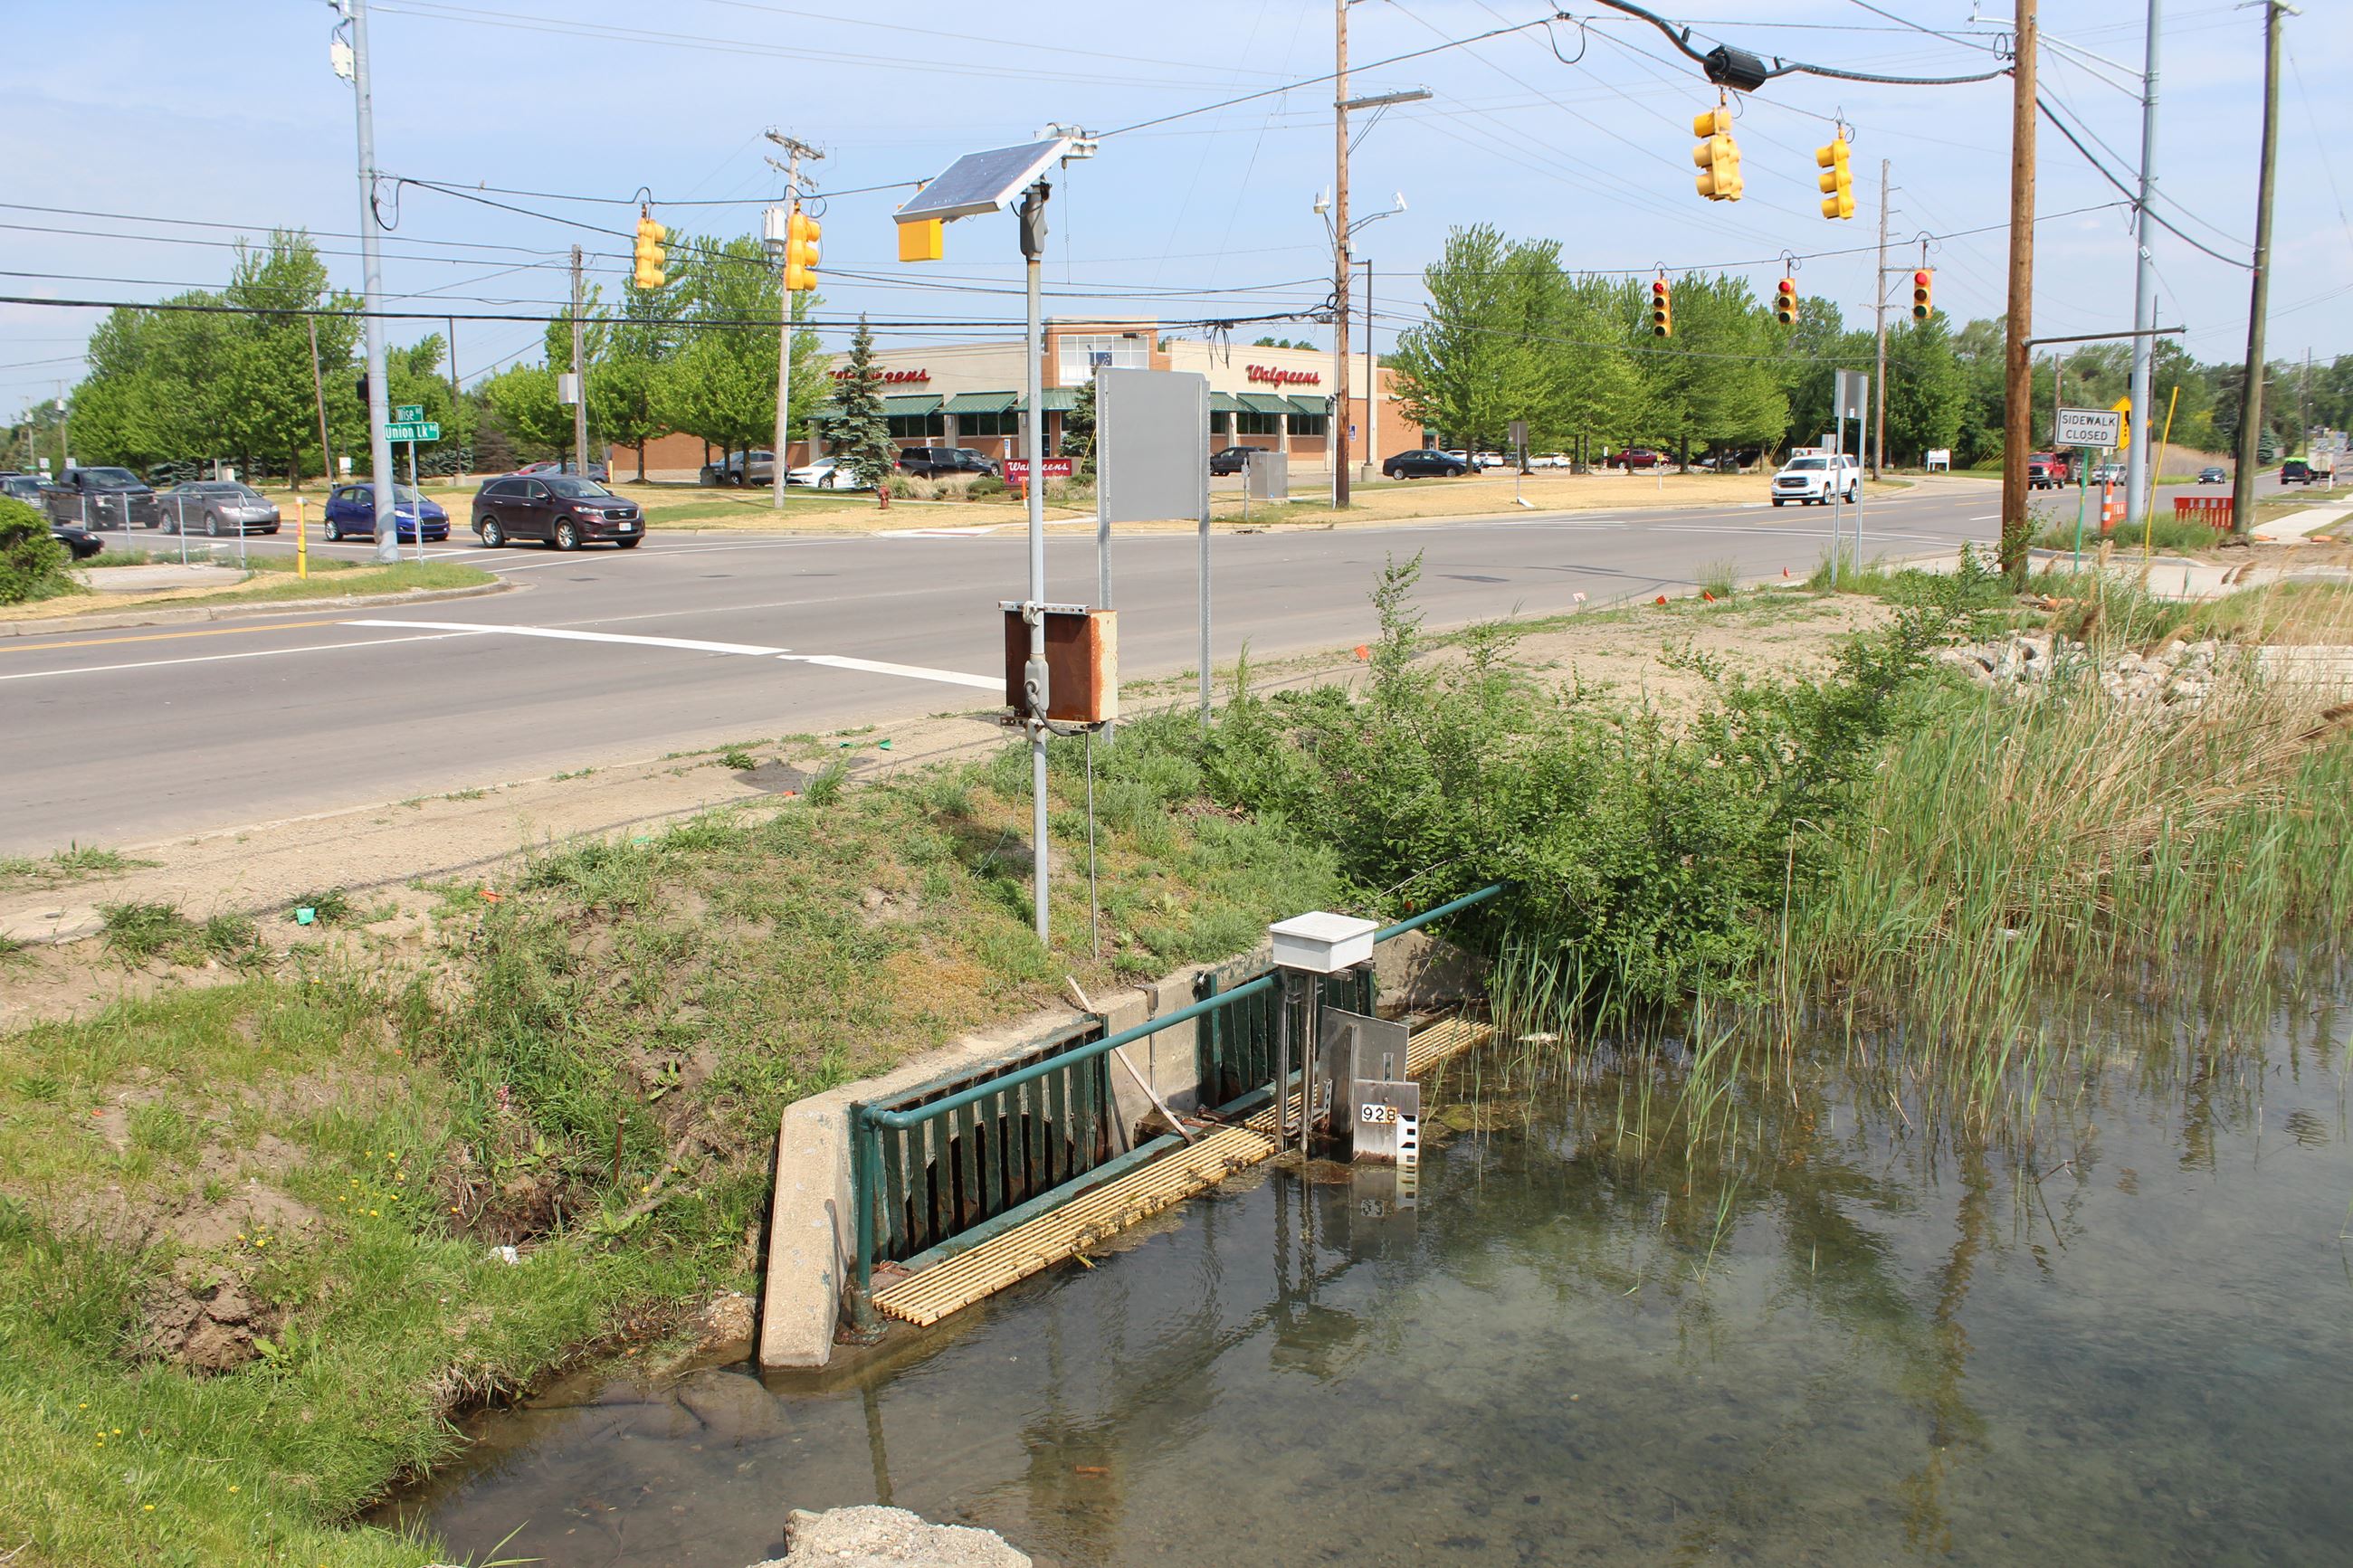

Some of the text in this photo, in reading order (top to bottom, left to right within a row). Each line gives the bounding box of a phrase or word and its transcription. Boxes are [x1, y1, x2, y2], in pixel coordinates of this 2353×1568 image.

[1245, 364, 1321, 387] Walgreens
[397, 407, 414, 421] Wise
[2062, 414, 2116, 427] SIDEWALK
[386, 425, 414, 439] Union
[416, 424, 429, 438] Lk
[2065, 430, 2108, 441] CLOSED
[1007, 461, 1069, 471] Waleens
[1363, 1106, 1396, 1122] 928
